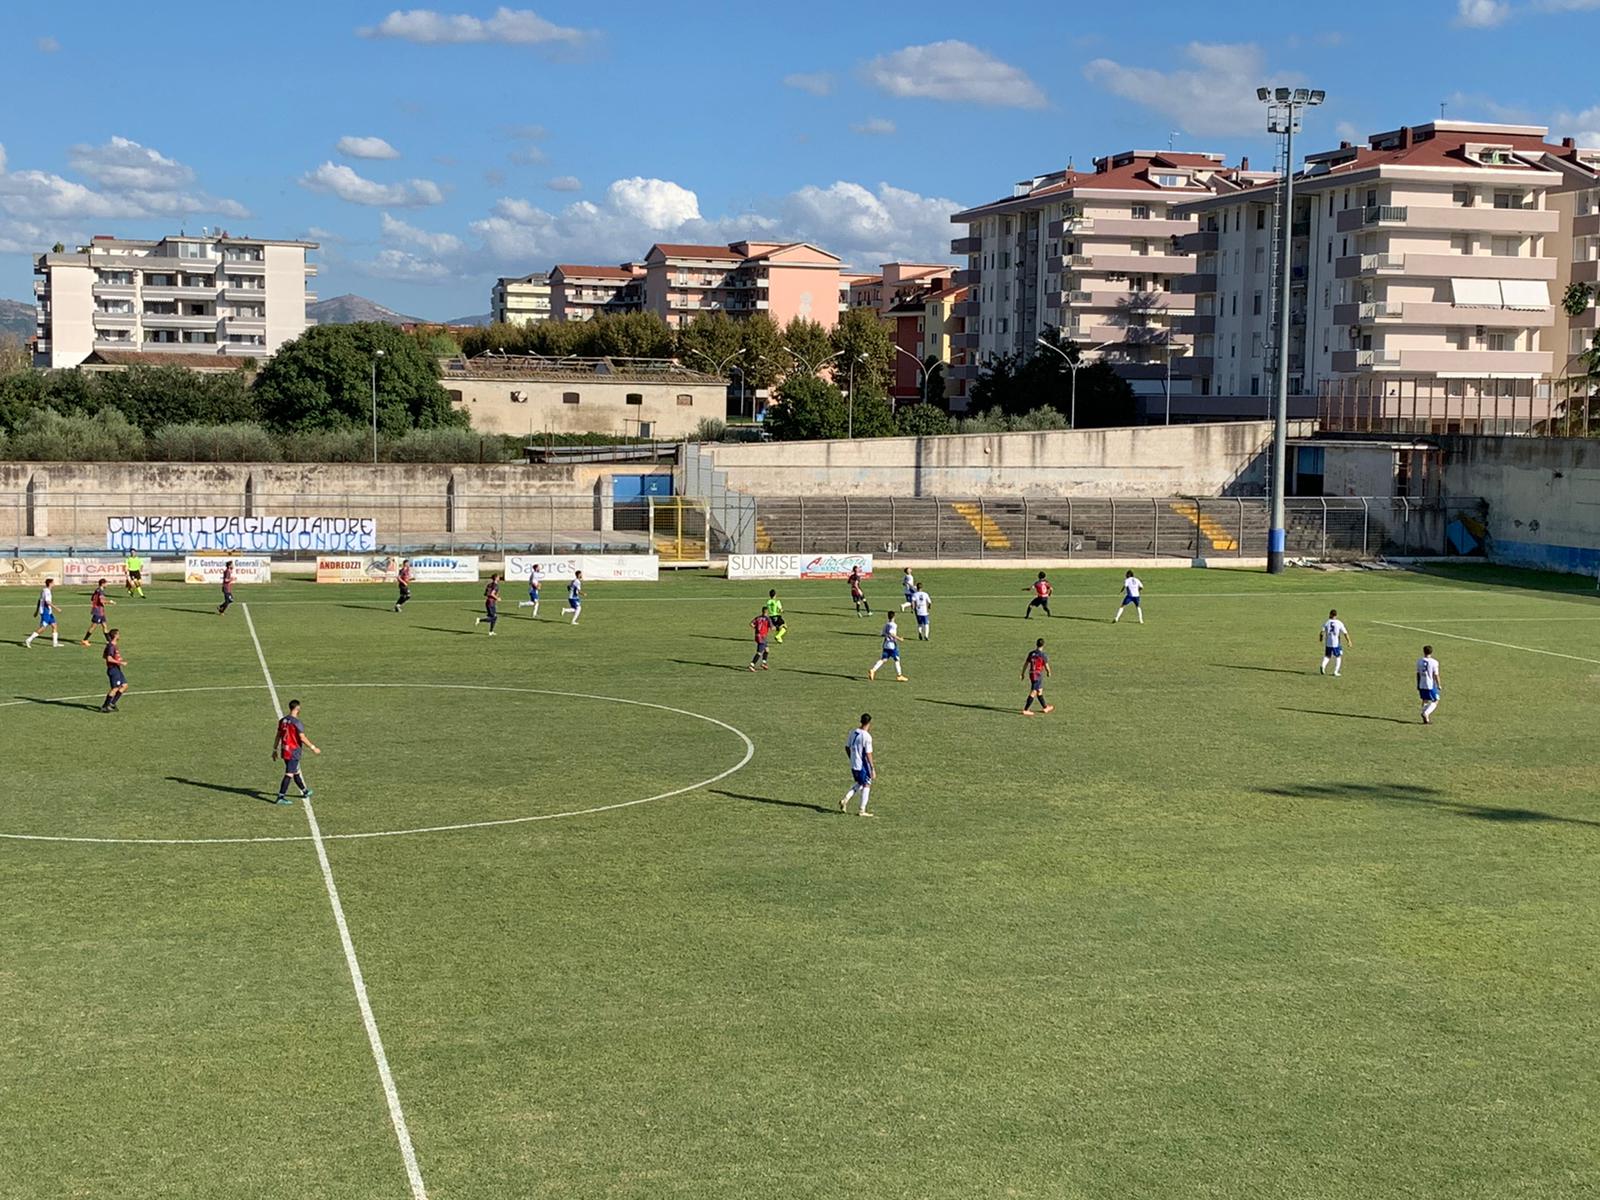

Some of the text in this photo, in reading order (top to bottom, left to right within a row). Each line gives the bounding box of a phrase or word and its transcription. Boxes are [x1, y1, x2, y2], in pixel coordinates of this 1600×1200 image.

[107, 516, 208, 535] COMBATTI
[188, 532, 247, 550] VINCI
[319, 561, 361, 570] ANDREOZZI
[731, 555, 799, 571] SUNRISE
[852, 731, 860, 745] 7
